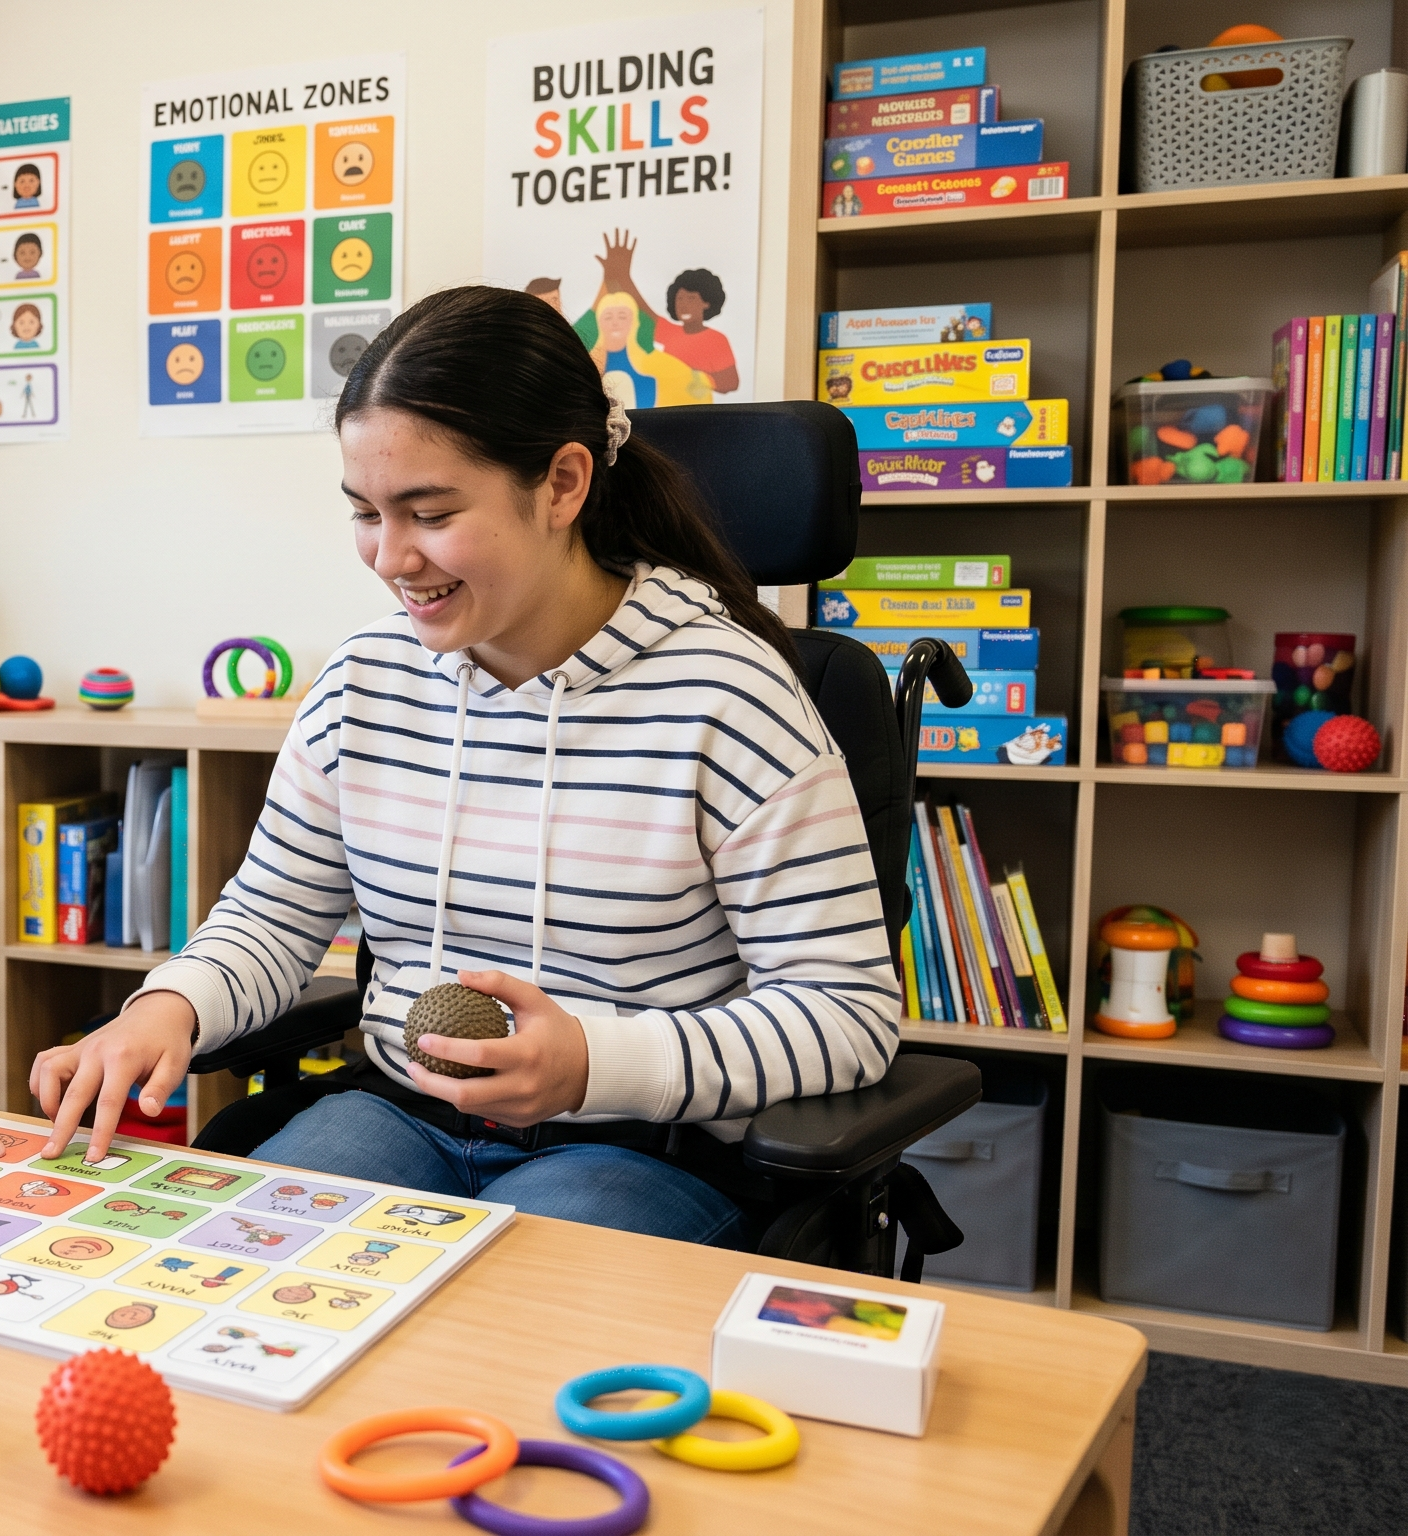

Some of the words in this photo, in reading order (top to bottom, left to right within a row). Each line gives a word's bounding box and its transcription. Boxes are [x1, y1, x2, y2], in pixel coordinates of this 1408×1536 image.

[154, 87, 294, 128] EMOTIONAL
[303, 76, 390, 110] ZONES
[533, 46, 714, 103] BUILDING
[533, 94, 710, 160] SKILLS
[511, 152, 732, 208] TOGETHER!
